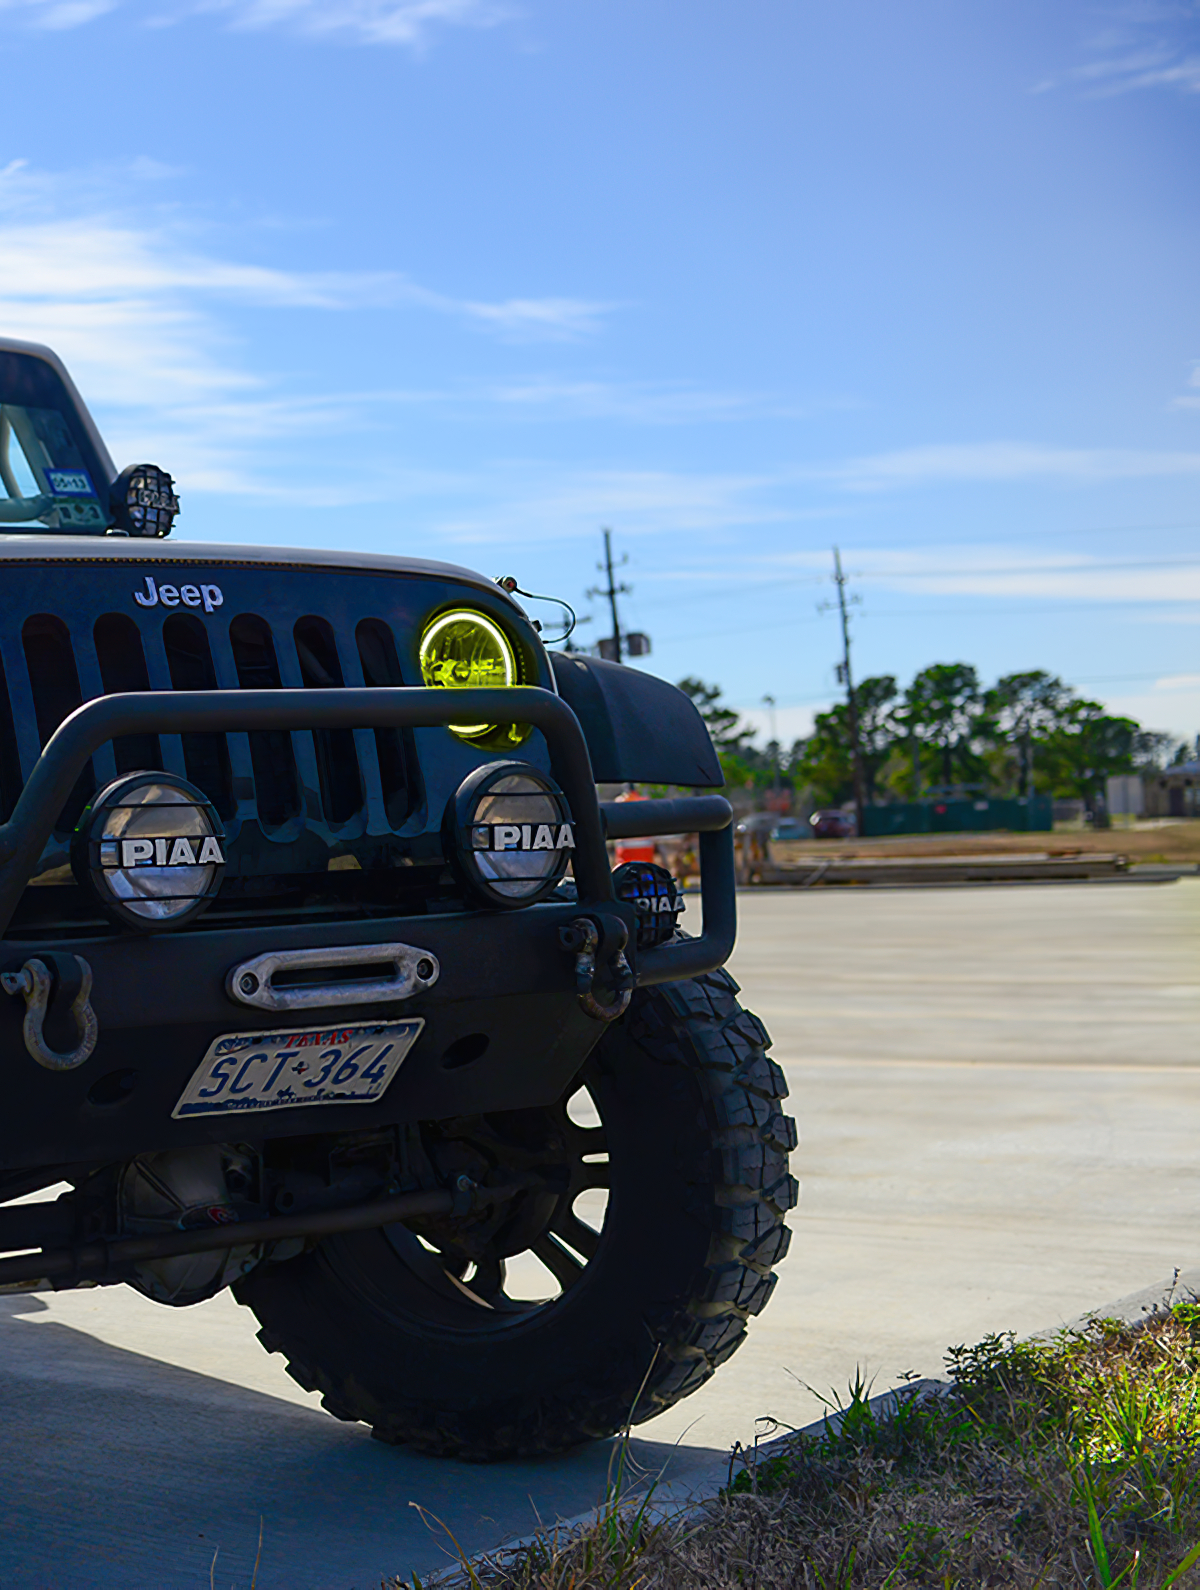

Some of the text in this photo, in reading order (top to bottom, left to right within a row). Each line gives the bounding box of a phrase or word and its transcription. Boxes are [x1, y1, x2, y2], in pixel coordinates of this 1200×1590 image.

[134, 576, 224, 613] Jeep
[122, 836, 226, 867] PIAA
[493, 823, 577, 851] PIAA
[285, 1029, 353, 1049] TEXAS
[198, 1043, 394, 1098] SCT 364
